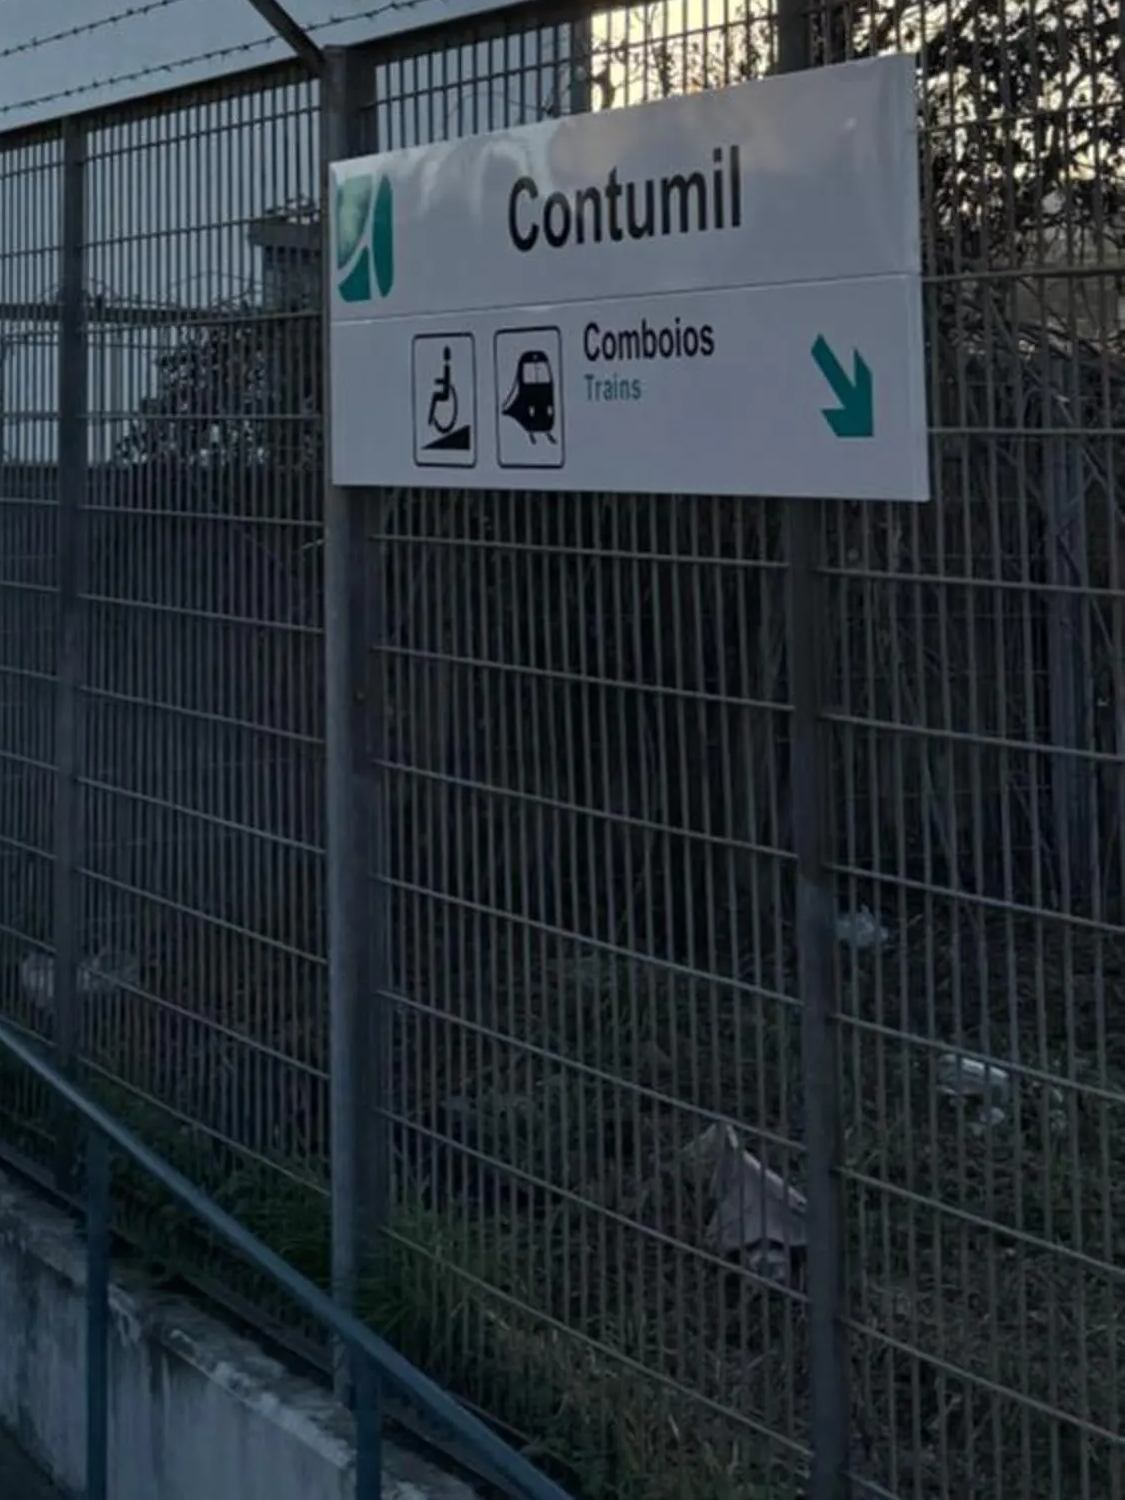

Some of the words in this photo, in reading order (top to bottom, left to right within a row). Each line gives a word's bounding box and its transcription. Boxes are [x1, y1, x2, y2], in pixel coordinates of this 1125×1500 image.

[508, 144, 743, 252] Contumil
[583, 317, 715, 362] Comboios
[585, 373, 642, 402] Trains
